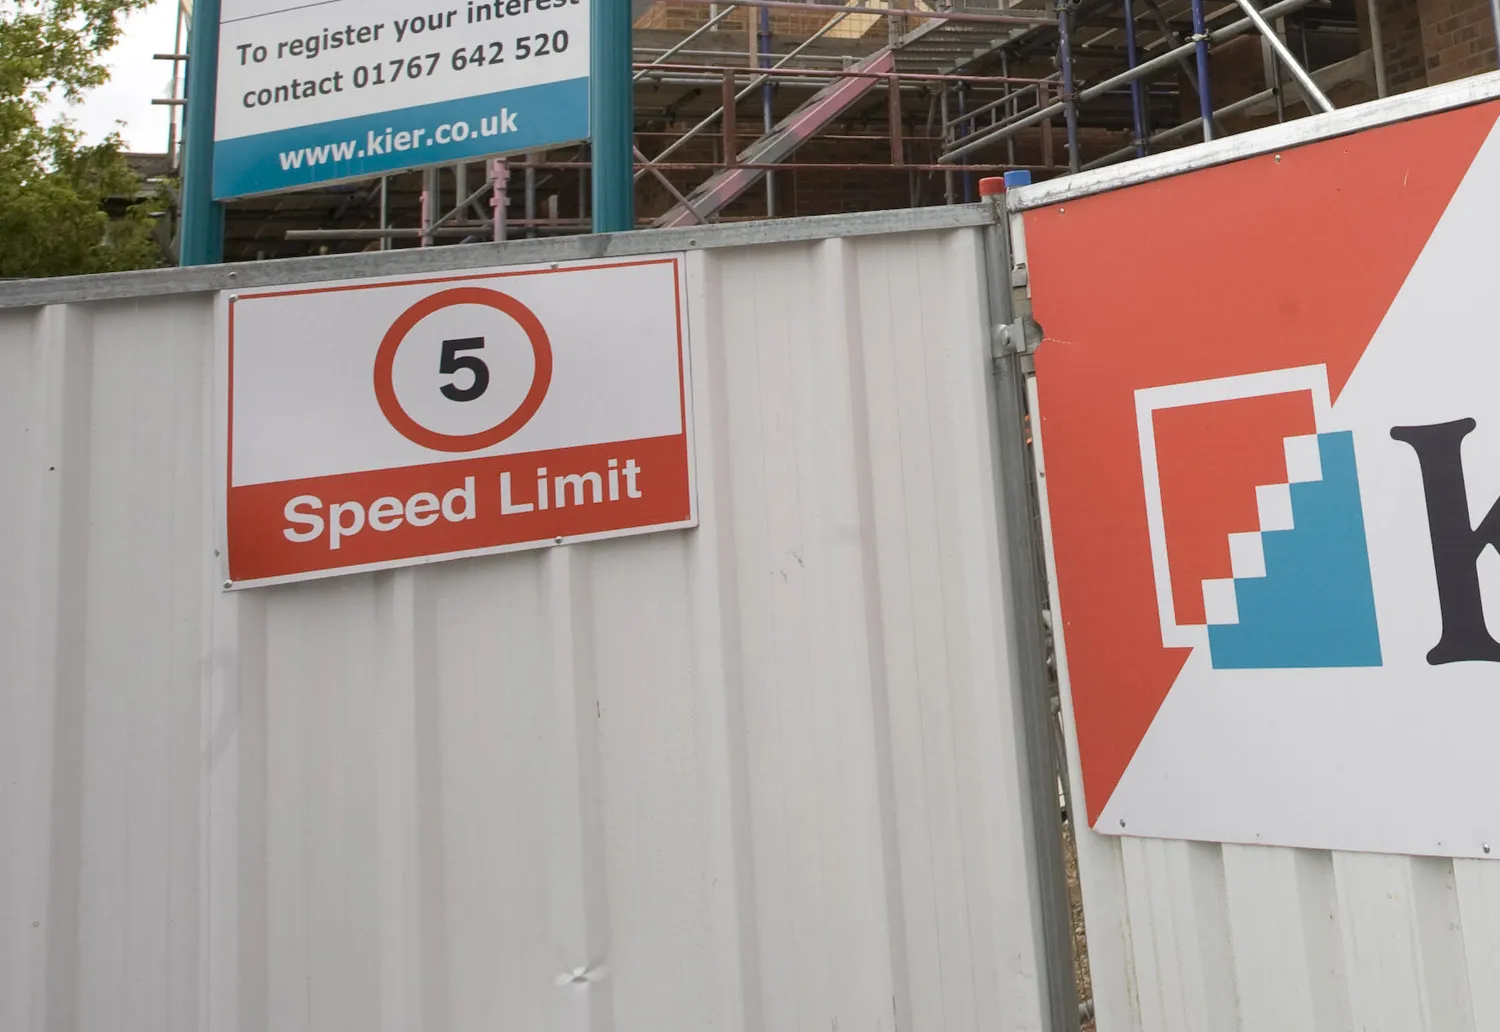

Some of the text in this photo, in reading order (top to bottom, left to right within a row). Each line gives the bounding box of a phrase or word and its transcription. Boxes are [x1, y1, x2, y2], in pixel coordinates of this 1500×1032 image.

[236, 44, 267, 65] To
[277, 24, 384, 59] register
[394, 7, 457, 41] your
[242, 30, 569, 107] contact 01767 642 520
[279, 108, 518, 170] www.kier.co.uk
[439, 336, 490, 402] 5
[282, 459, 642, 550] Speed Limit
